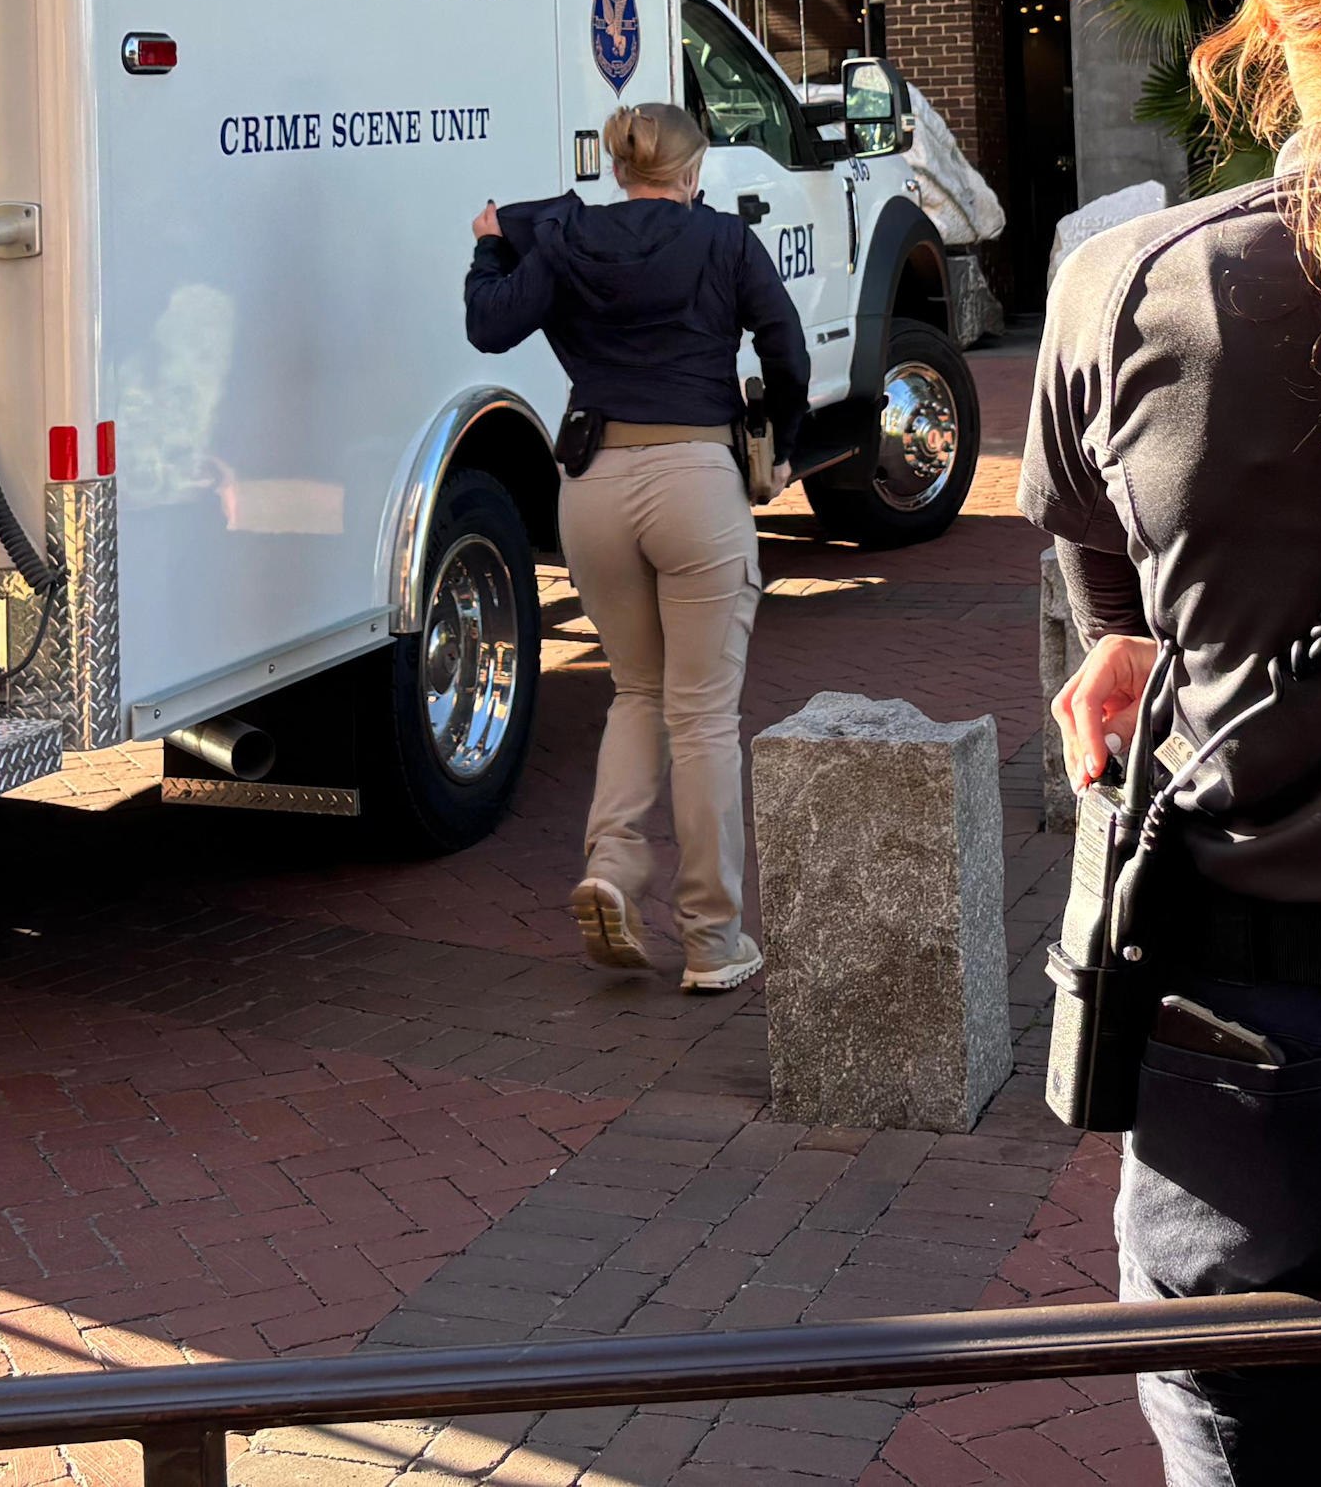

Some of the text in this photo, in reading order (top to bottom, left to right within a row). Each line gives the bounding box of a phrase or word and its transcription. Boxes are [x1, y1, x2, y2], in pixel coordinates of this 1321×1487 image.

[219, 107, 490, 156] CRIME SCENE UNIT
[778, 222, 815, 283] GBI
